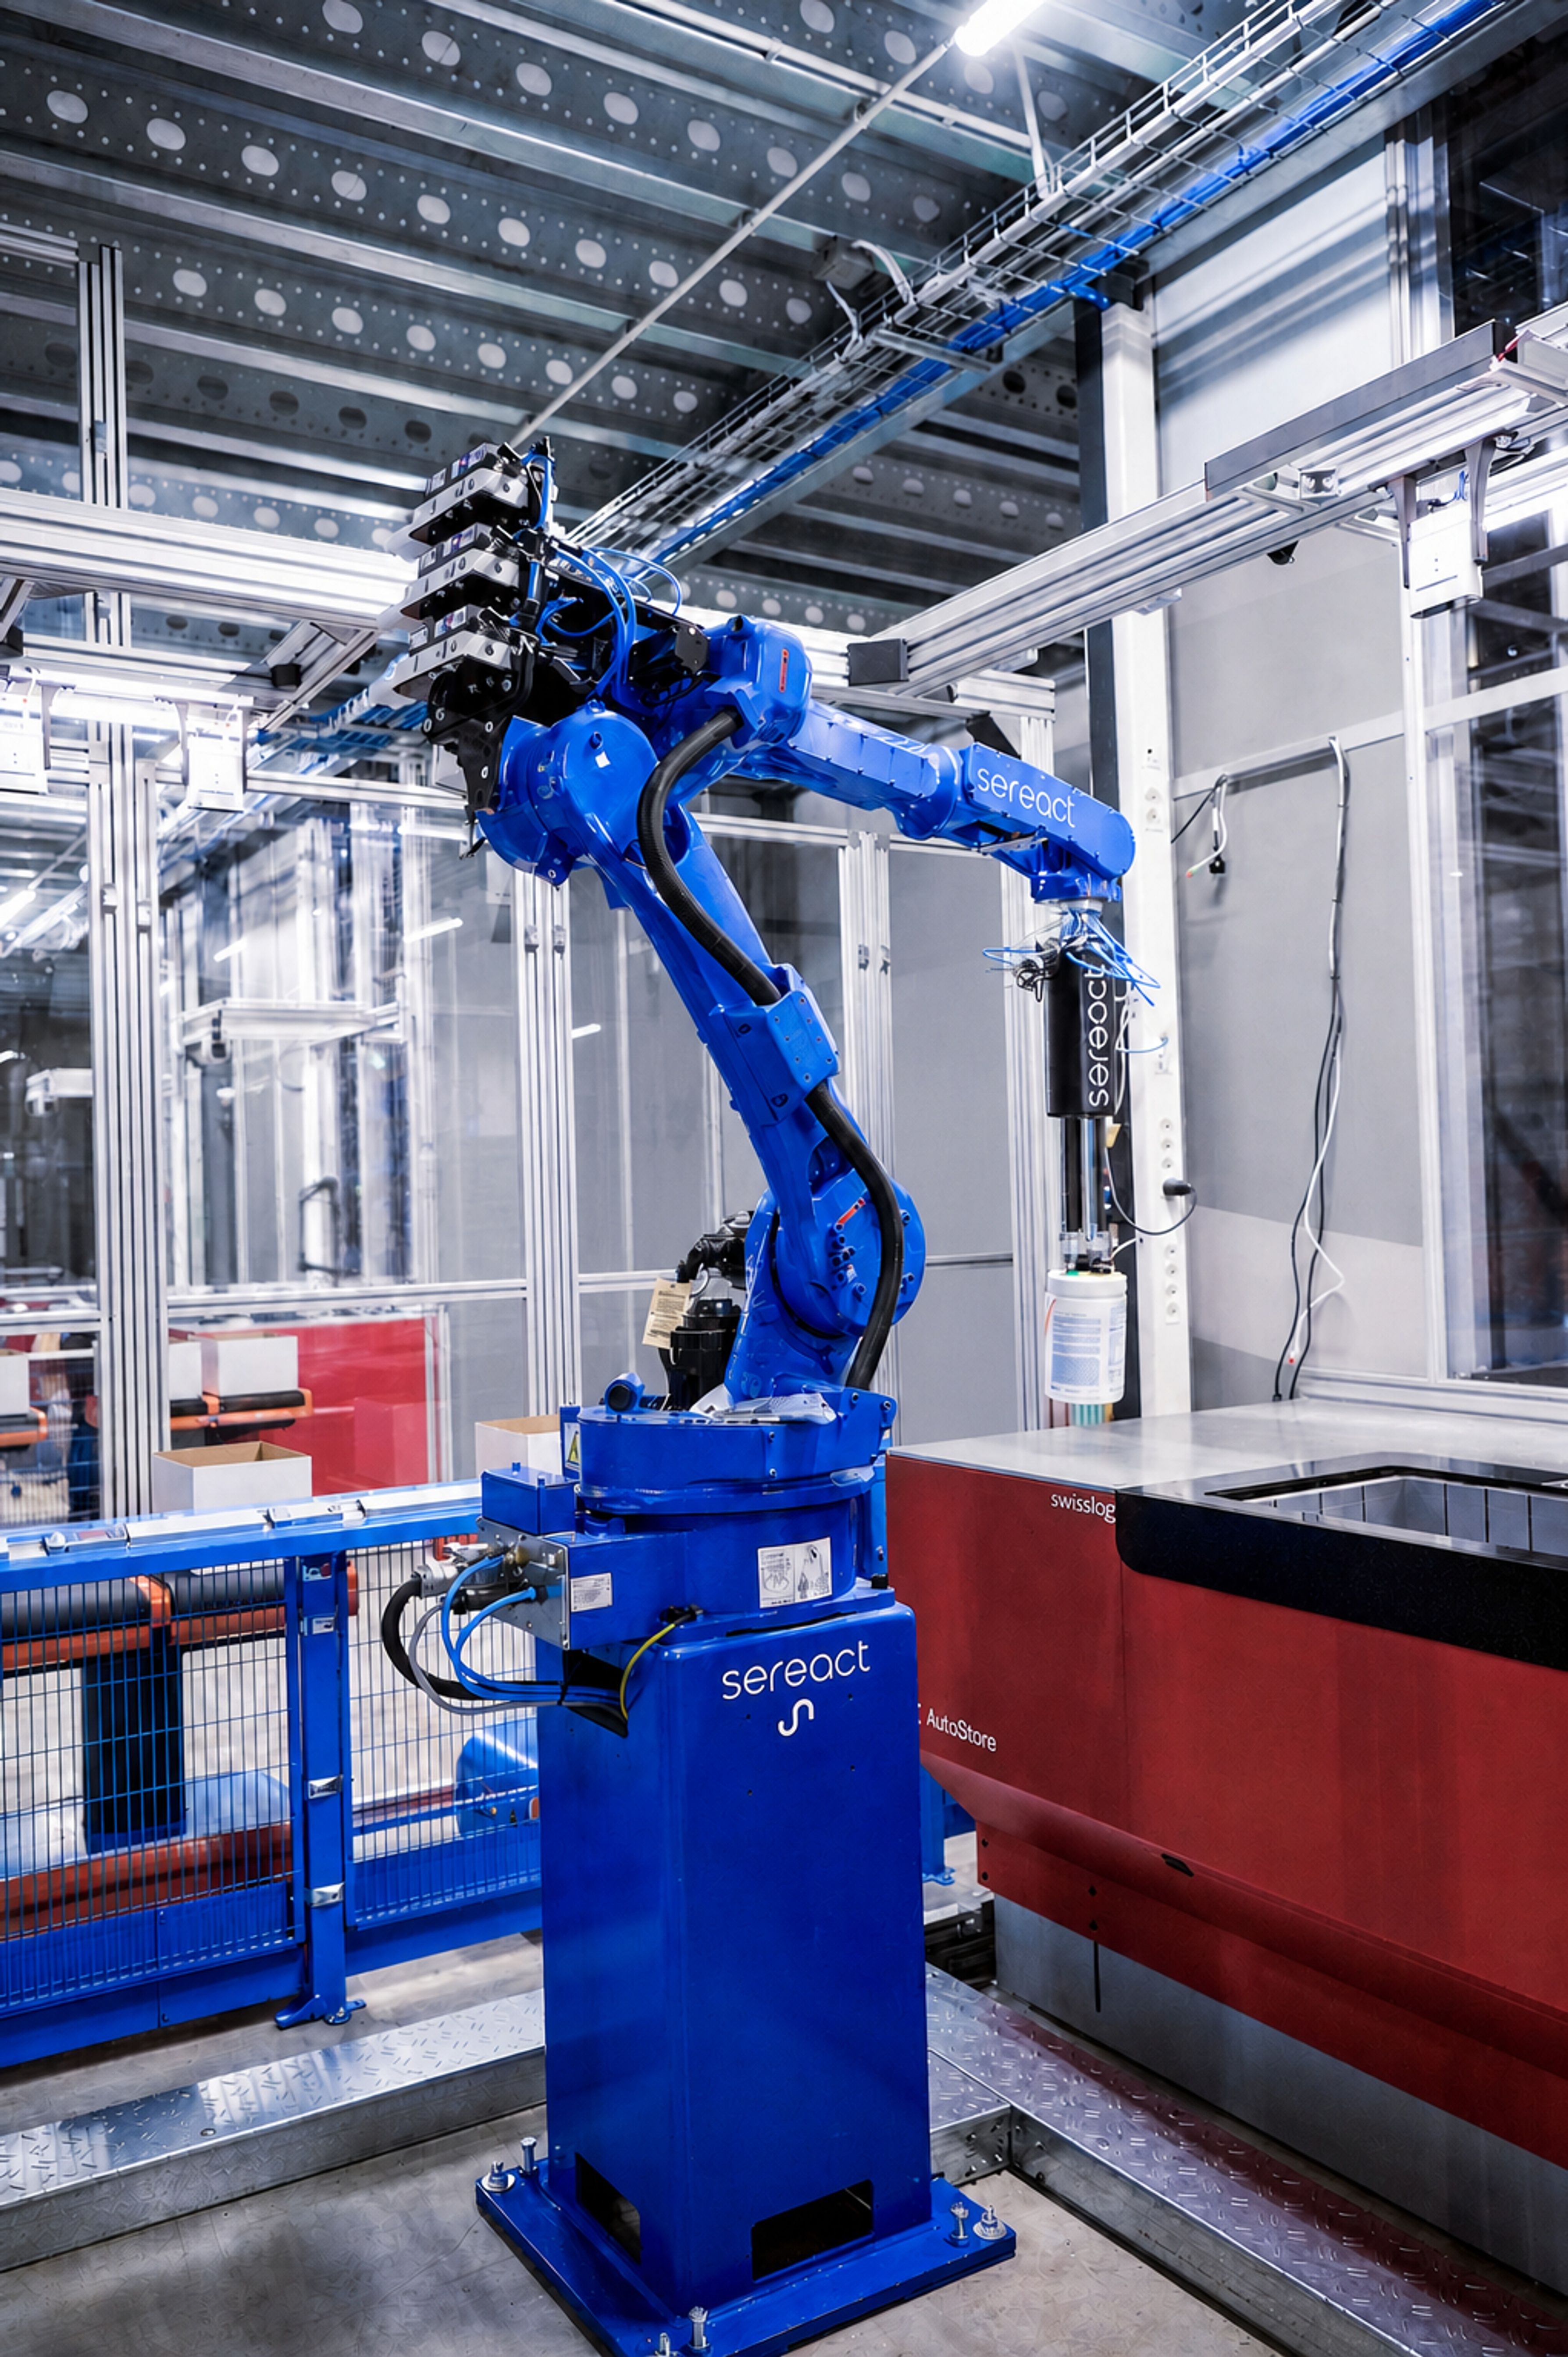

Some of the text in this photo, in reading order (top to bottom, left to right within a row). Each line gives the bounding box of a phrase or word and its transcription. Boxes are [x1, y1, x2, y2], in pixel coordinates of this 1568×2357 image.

[976, 768, 1075, 828] sereact
[1084, 964, 1109, 1107] sereact
[1051, 1493, 1116, 1523] swisslog
[722, 1640, 870, 1700] sereact
[927, 1708, 996, 1752] AutoStore
